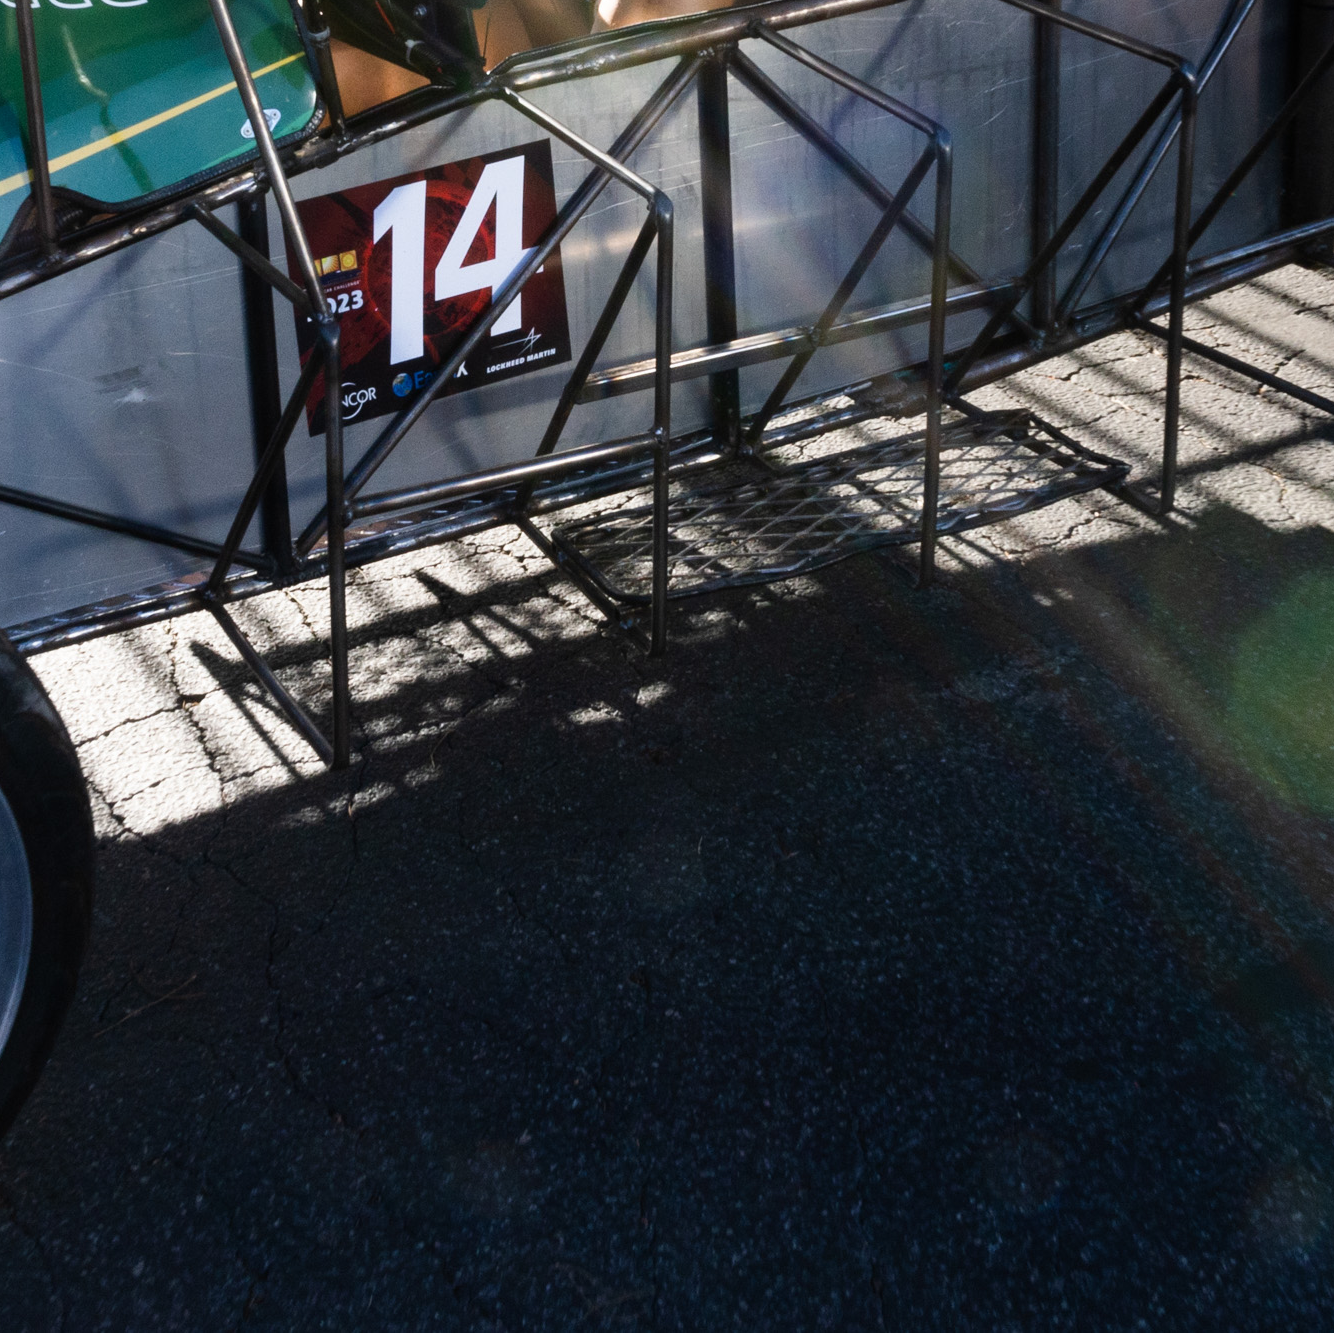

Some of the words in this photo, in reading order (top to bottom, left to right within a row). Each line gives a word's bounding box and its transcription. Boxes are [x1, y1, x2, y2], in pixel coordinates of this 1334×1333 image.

[373, 155, 544, 366] 14
[486, 357, 525, 374] LOCKHEED
[526, 348, 556, 362] MARTIN
[341, 386, 377, 408] NCOR
